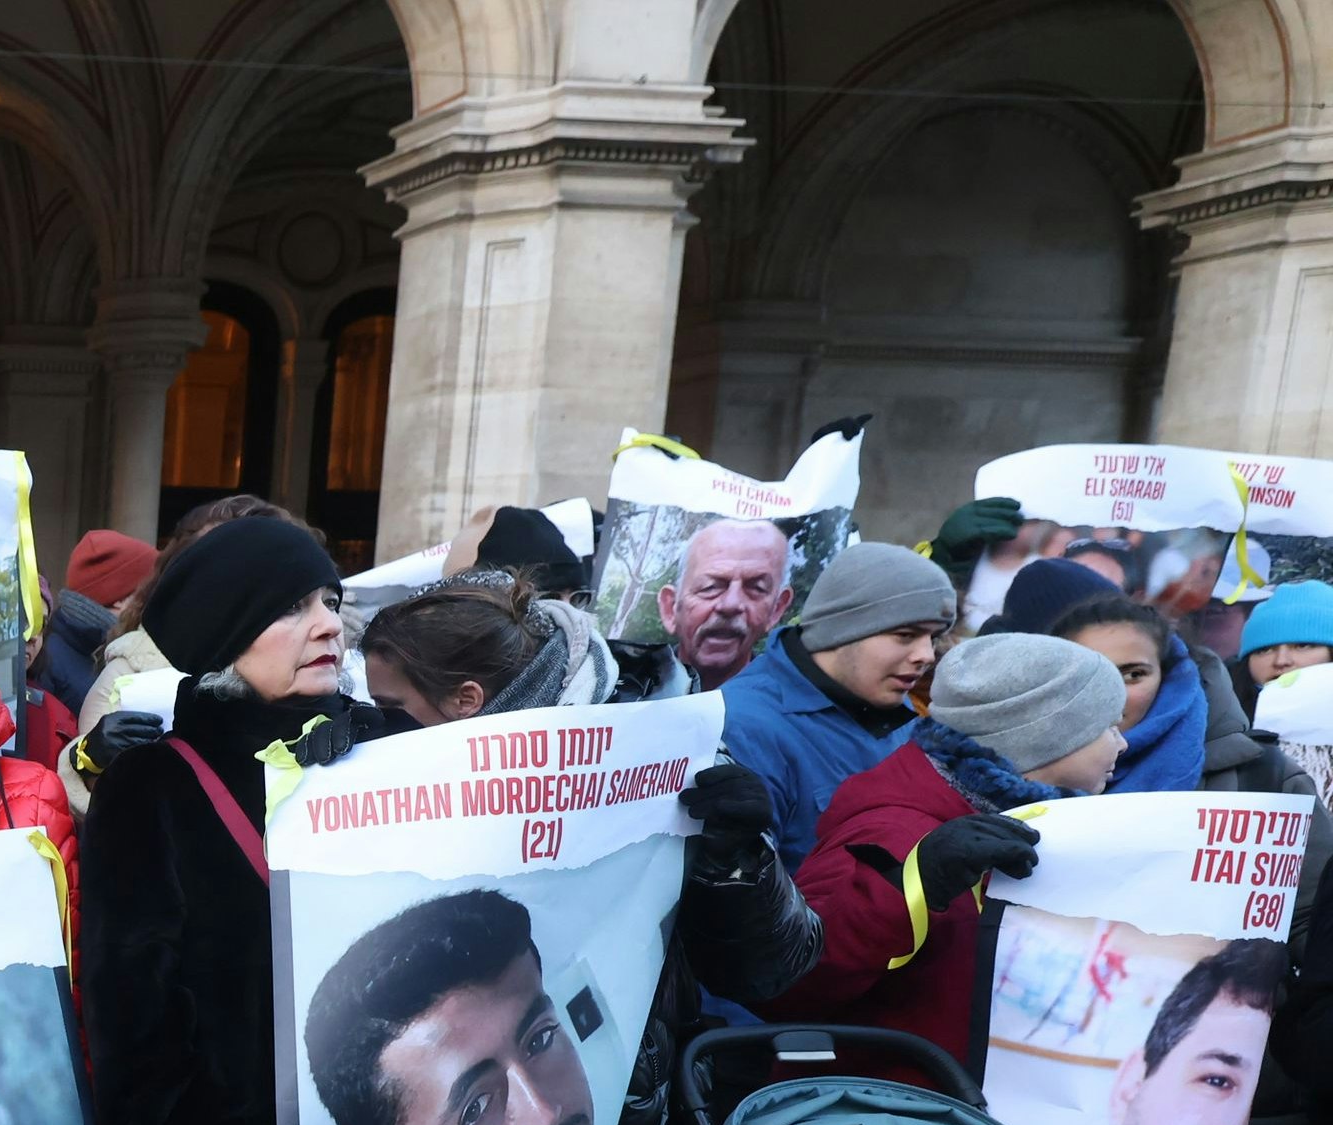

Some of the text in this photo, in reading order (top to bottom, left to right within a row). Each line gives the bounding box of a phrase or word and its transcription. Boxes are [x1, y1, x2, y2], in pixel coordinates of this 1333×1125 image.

[1094, 455, 1166, 476] אלי שרעבי
[1085, 478, 1167, 500] ELI SHARABI
[1111, 500, 1134, 522] (51)
[467, 726, 613, 772] יונתן סמרנו
[306, 757, 690, 834] YONATHAN MORDECHAI SAMERANO
[521, 817, 563, 864] (21)
[1197, 808, 1301, 847] סבירסקי
[1191, 849, 1247, 884] ITAI
[1242, 891, 1286, 931] (38)
